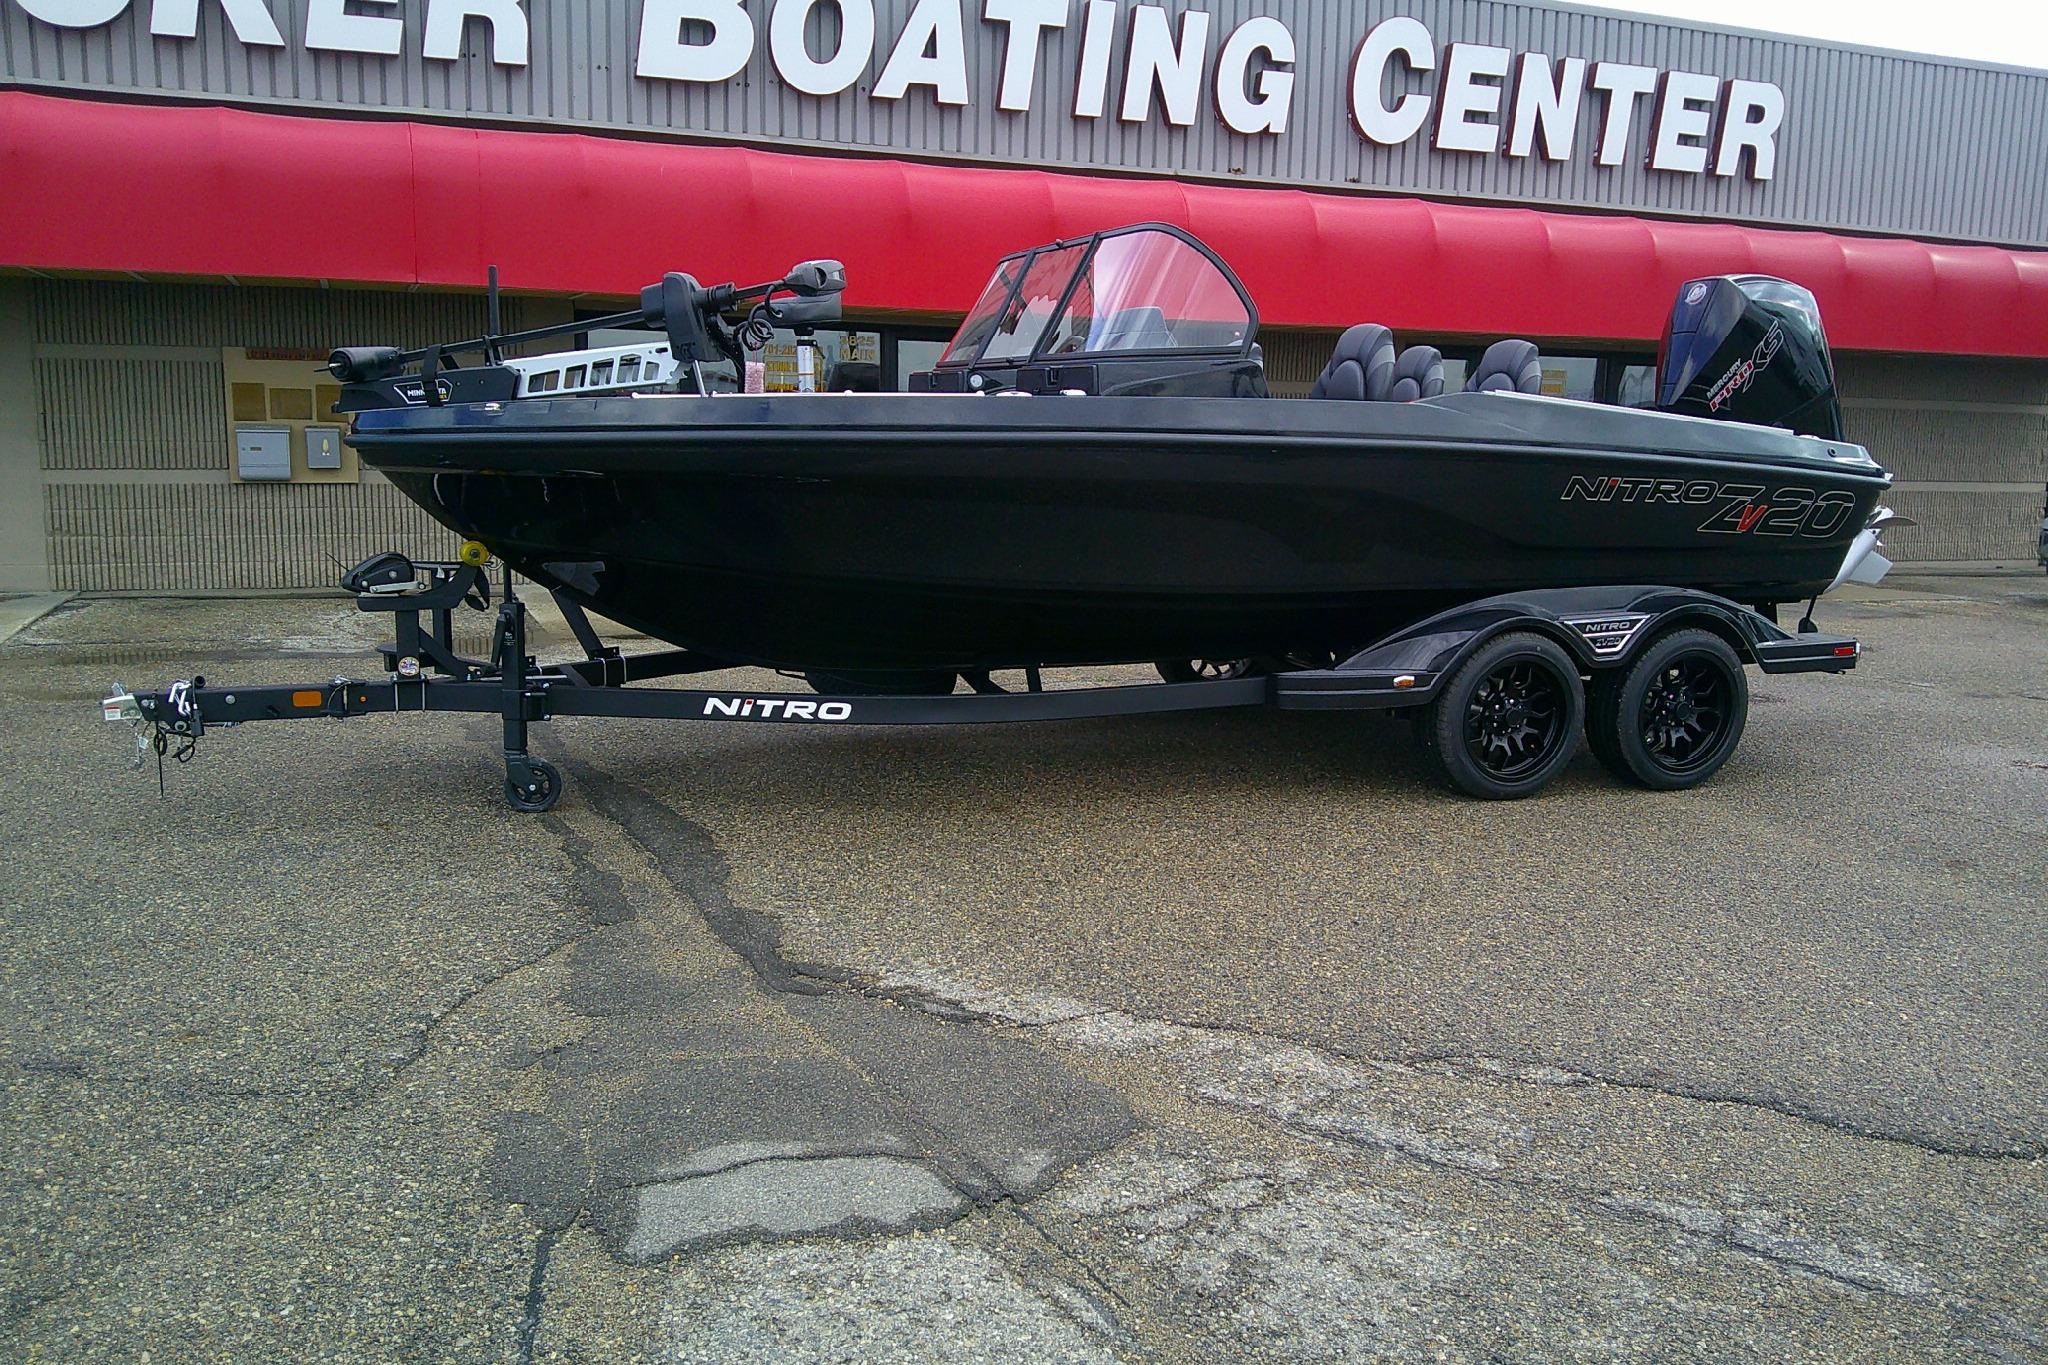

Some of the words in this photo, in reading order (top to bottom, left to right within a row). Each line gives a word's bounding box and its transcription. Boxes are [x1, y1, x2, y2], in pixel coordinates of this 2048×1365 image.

[635, 0, 1296, 134] BOATING
[1349, 16, 1785, 181] CENTER
[1706, 358, 1741, 399] MERCURY
[1561, 475, 1718, 503] NITRO
[1585, 621, 1631, 632] NITRO
[703, 697, 852, 720] NITRO
